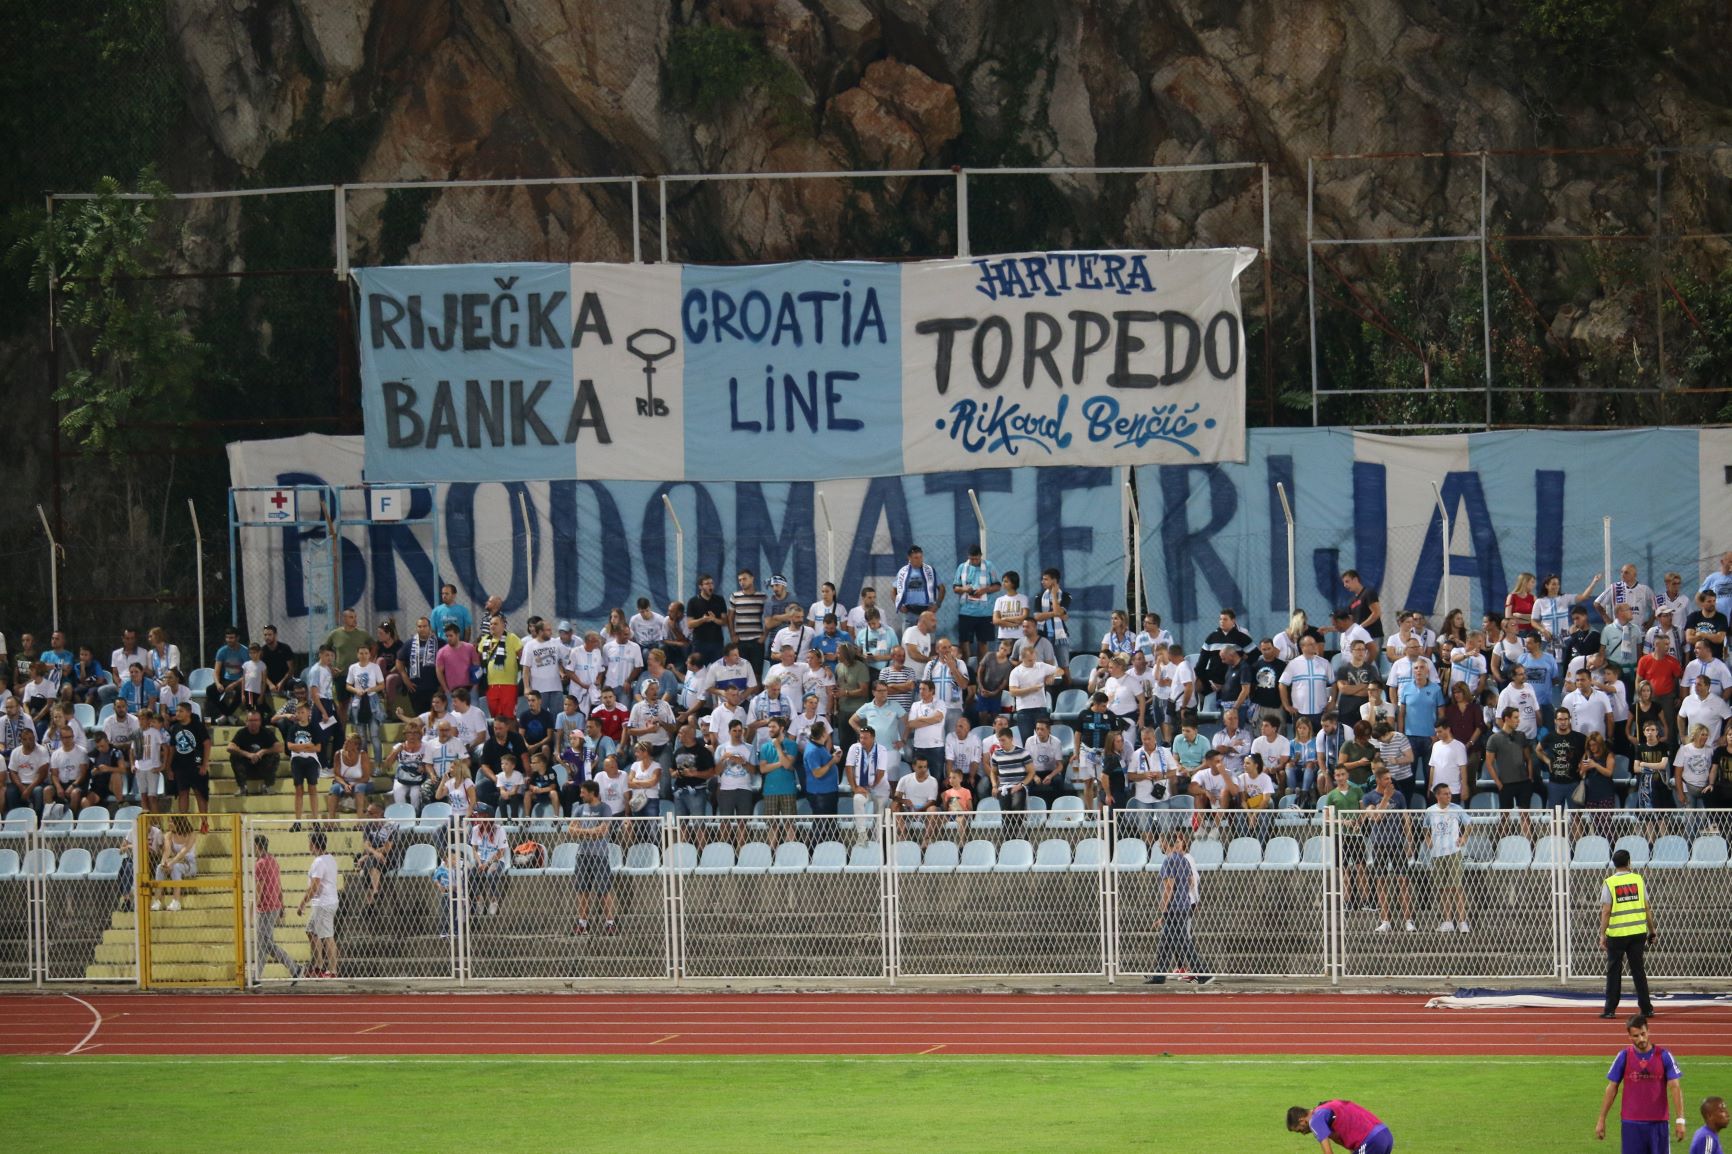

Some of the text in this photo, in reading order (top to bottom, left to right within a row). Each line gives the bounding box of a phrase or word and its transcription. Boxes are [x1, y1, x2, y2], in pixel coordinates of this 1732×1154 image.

[970, 253, 1156, 301] HARTERA
[368, 276, 614, 351] RIJEČKA
[915, 309, 1239, 394] TORPEDO
[382, 379, 613, 449] BANKA
[1081, 394, 1200, 457] Benčić
[381, 496, 392, 513] F
